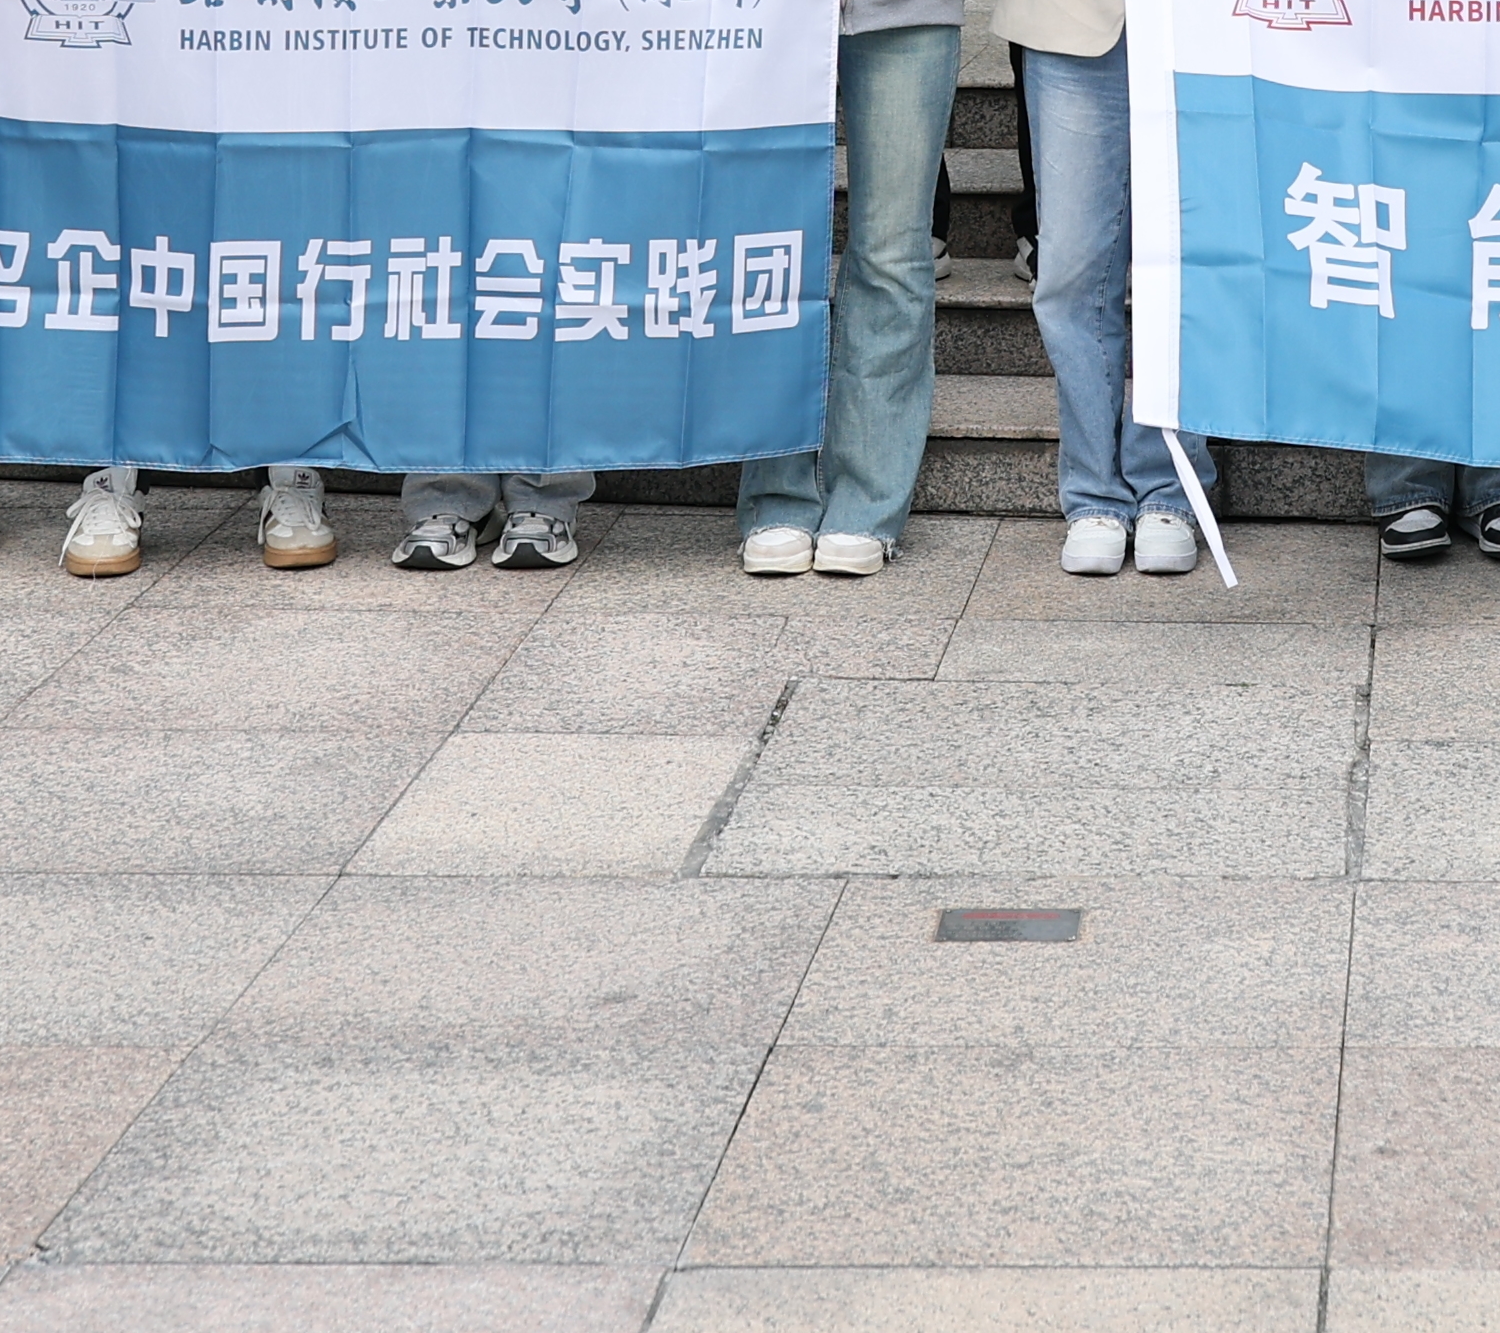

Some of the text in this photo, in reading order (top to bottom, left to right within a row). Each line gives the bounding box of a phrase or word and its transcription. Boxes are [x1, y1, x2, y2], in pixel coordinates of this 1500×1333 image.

[64, 3, 96, 11] 1920
[55, 20, 104, 30] HIT
[180, 26, 764, 54] HARBIN INSTITUTE OF TECHNOLOGY, SHENZHEN
